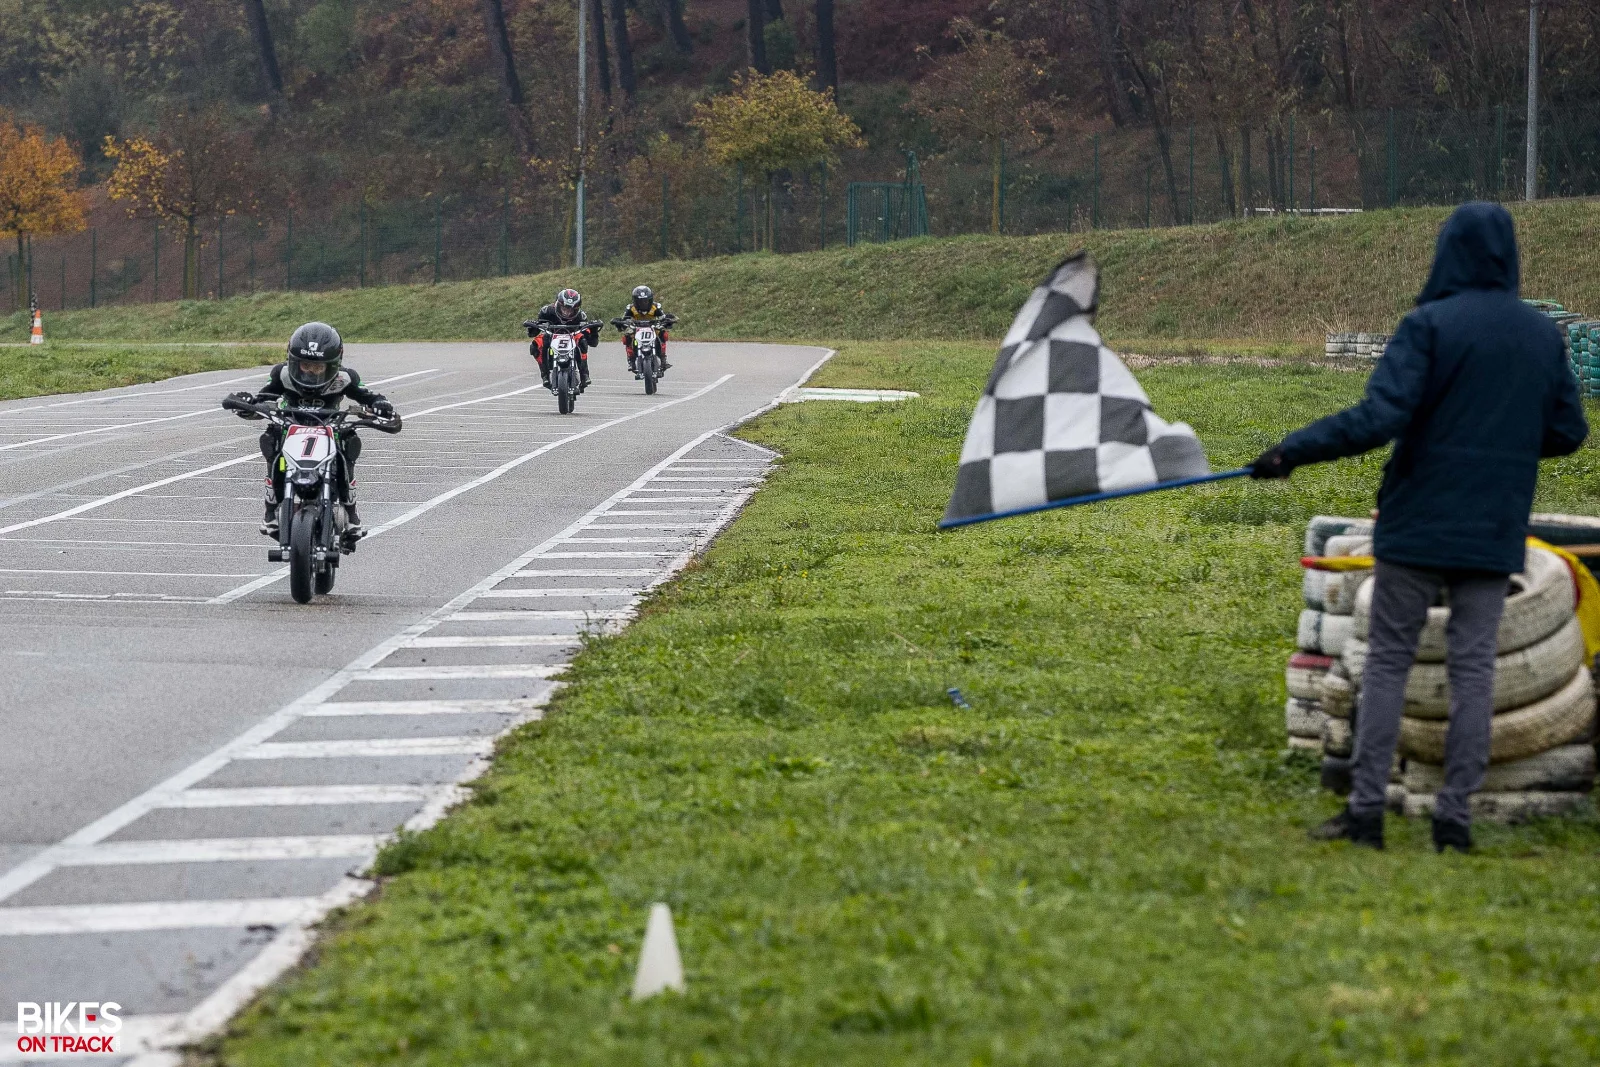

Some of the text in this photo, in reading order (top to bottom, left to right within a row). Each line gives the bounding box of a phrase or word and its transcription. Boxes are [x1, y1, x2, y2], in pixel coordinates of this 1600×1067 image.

[641, 331, 652, 340] 10
[558, 340, 568, 349] 5
[300, 349, 324, 357] SHARK
[301, 435, 318, 457] 1
